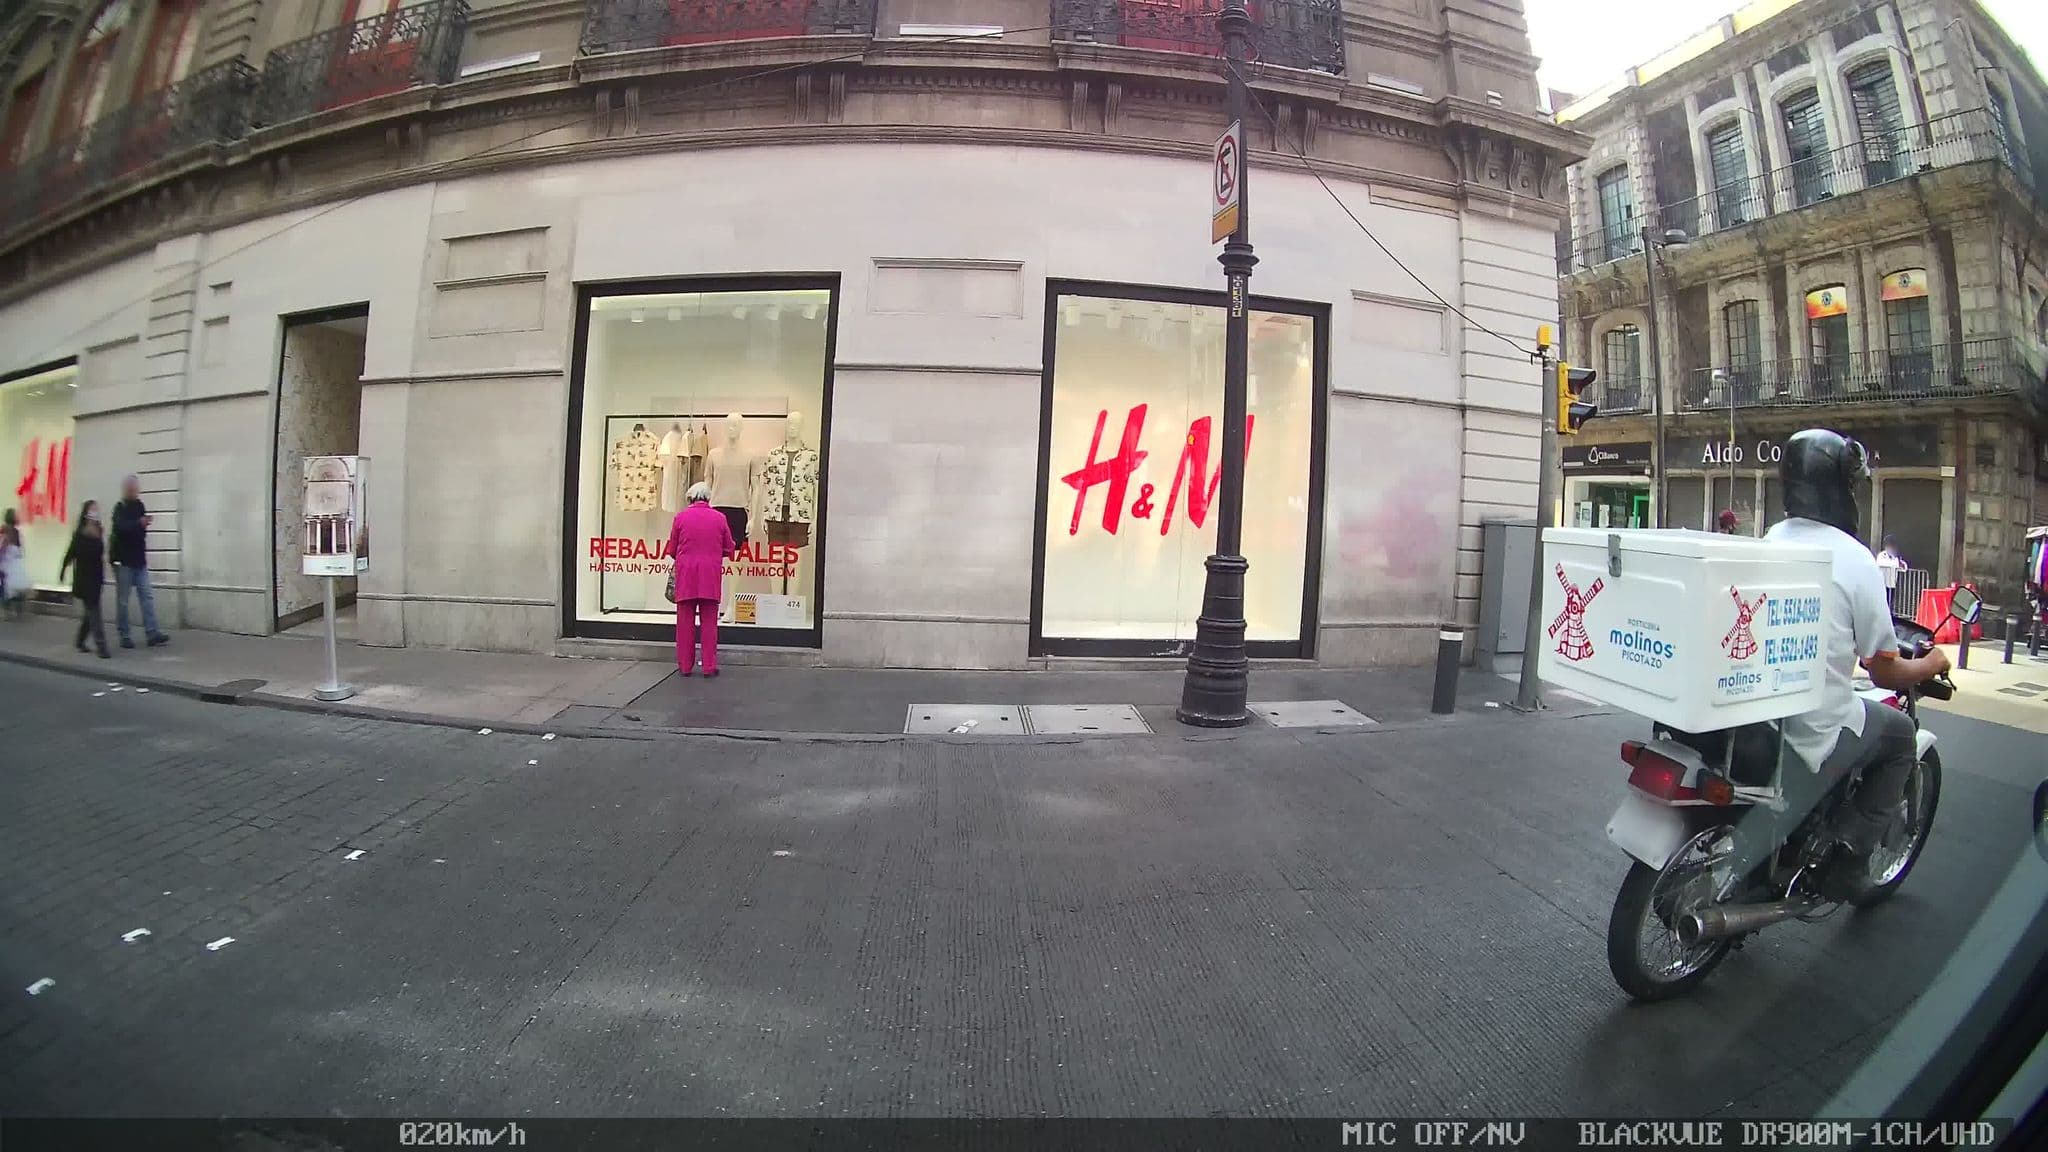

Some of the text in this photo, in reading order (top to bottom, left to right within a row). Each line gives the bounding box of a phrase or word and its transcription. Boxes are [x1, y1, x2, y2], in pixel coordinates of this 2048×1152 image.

[1702, 440, 1781, 463] Aldo Co
[1061, 404, 1254, 536] H&M
[590, 538, 674, 560] REBAJA
[590, 563, 623, 572] HASTA
[626, 564, 641, 573] UN
[736, 566, 743, 576] Y
[747, 566, 795, 577] HM.COM
[1610, 629, 1673, 658] molinos
[1622, 650, 1662, 669] PICOTAZO
[1718, 672, 1762, 688] molinos
